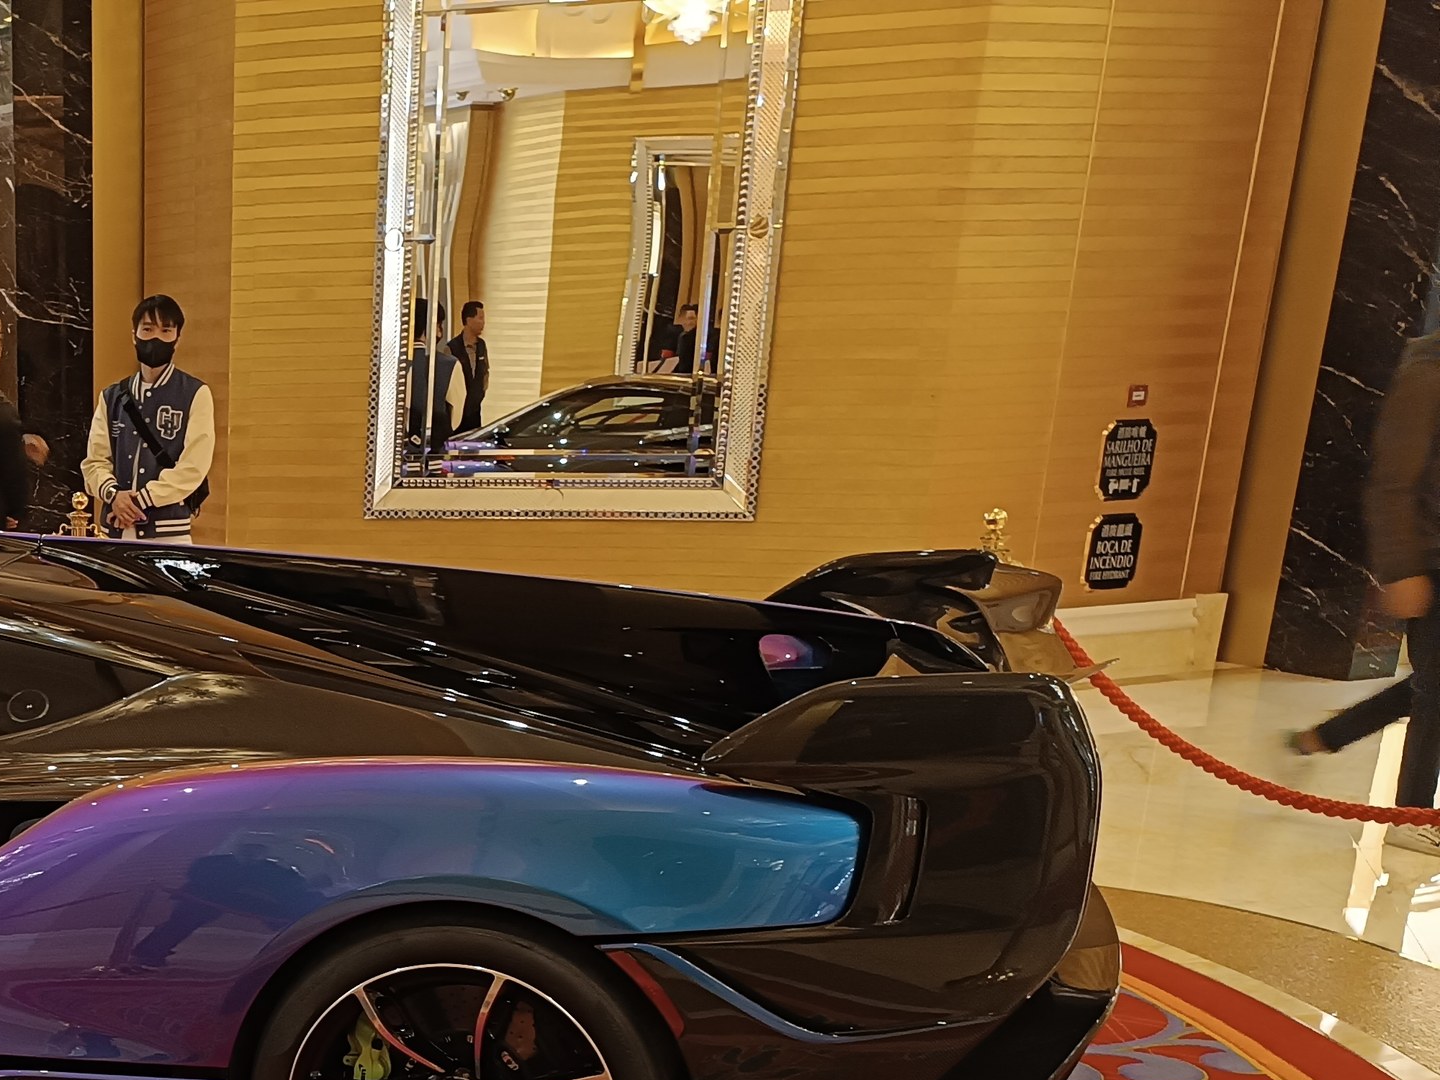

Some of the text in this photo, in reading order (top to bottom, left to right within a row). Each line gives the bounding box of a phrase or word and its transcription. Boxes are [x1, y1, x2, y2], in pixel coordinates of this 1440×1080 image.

[1105, 439, 1153, 455] SARILHO DE
[1103, 452, 1151, 468] MANGUEIRA
[1120, 540, 1133, 553] DE
